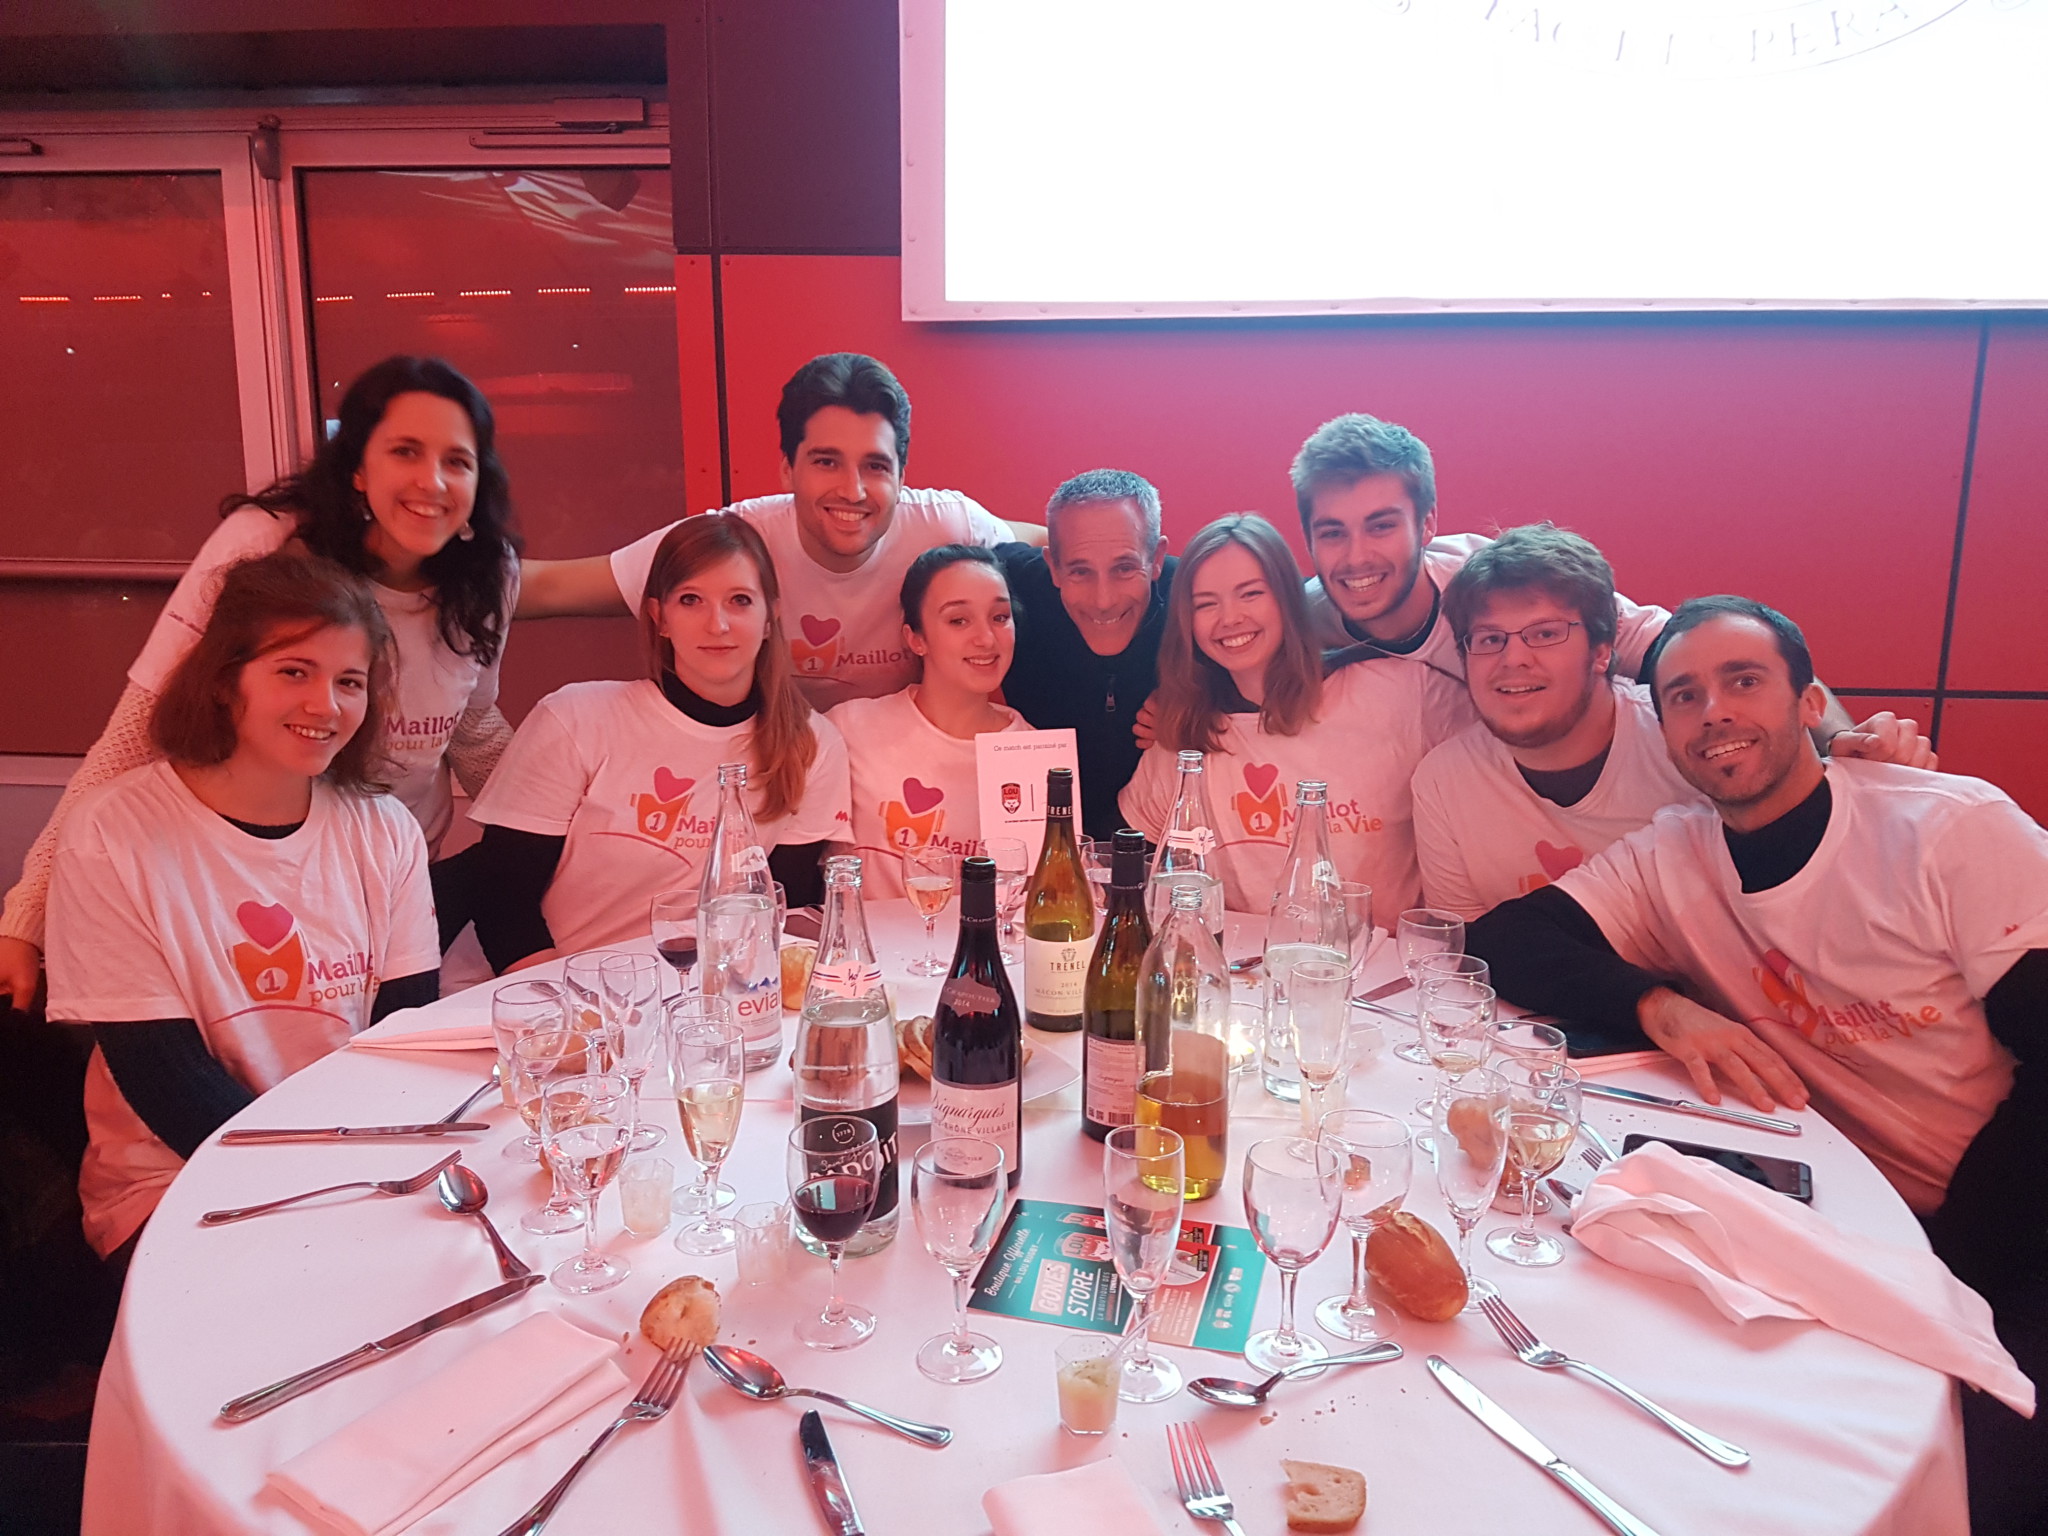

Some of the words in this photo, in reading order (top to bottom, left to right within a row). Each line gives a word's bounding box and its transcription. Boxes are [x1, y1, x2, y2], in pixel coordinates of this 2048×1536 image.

[1345, 815, 1383, 834] Vie
[899, 829, 910, 847] 1
[1050, 960, 1085, 971] TRENEL
[737, 991, 780, 1017] evia
[1887, 1005, 1942, 1039] Vie
[1037, 1261, 1067, 1313] GONES
[1067, 1268, 1094, 1317] STORE
